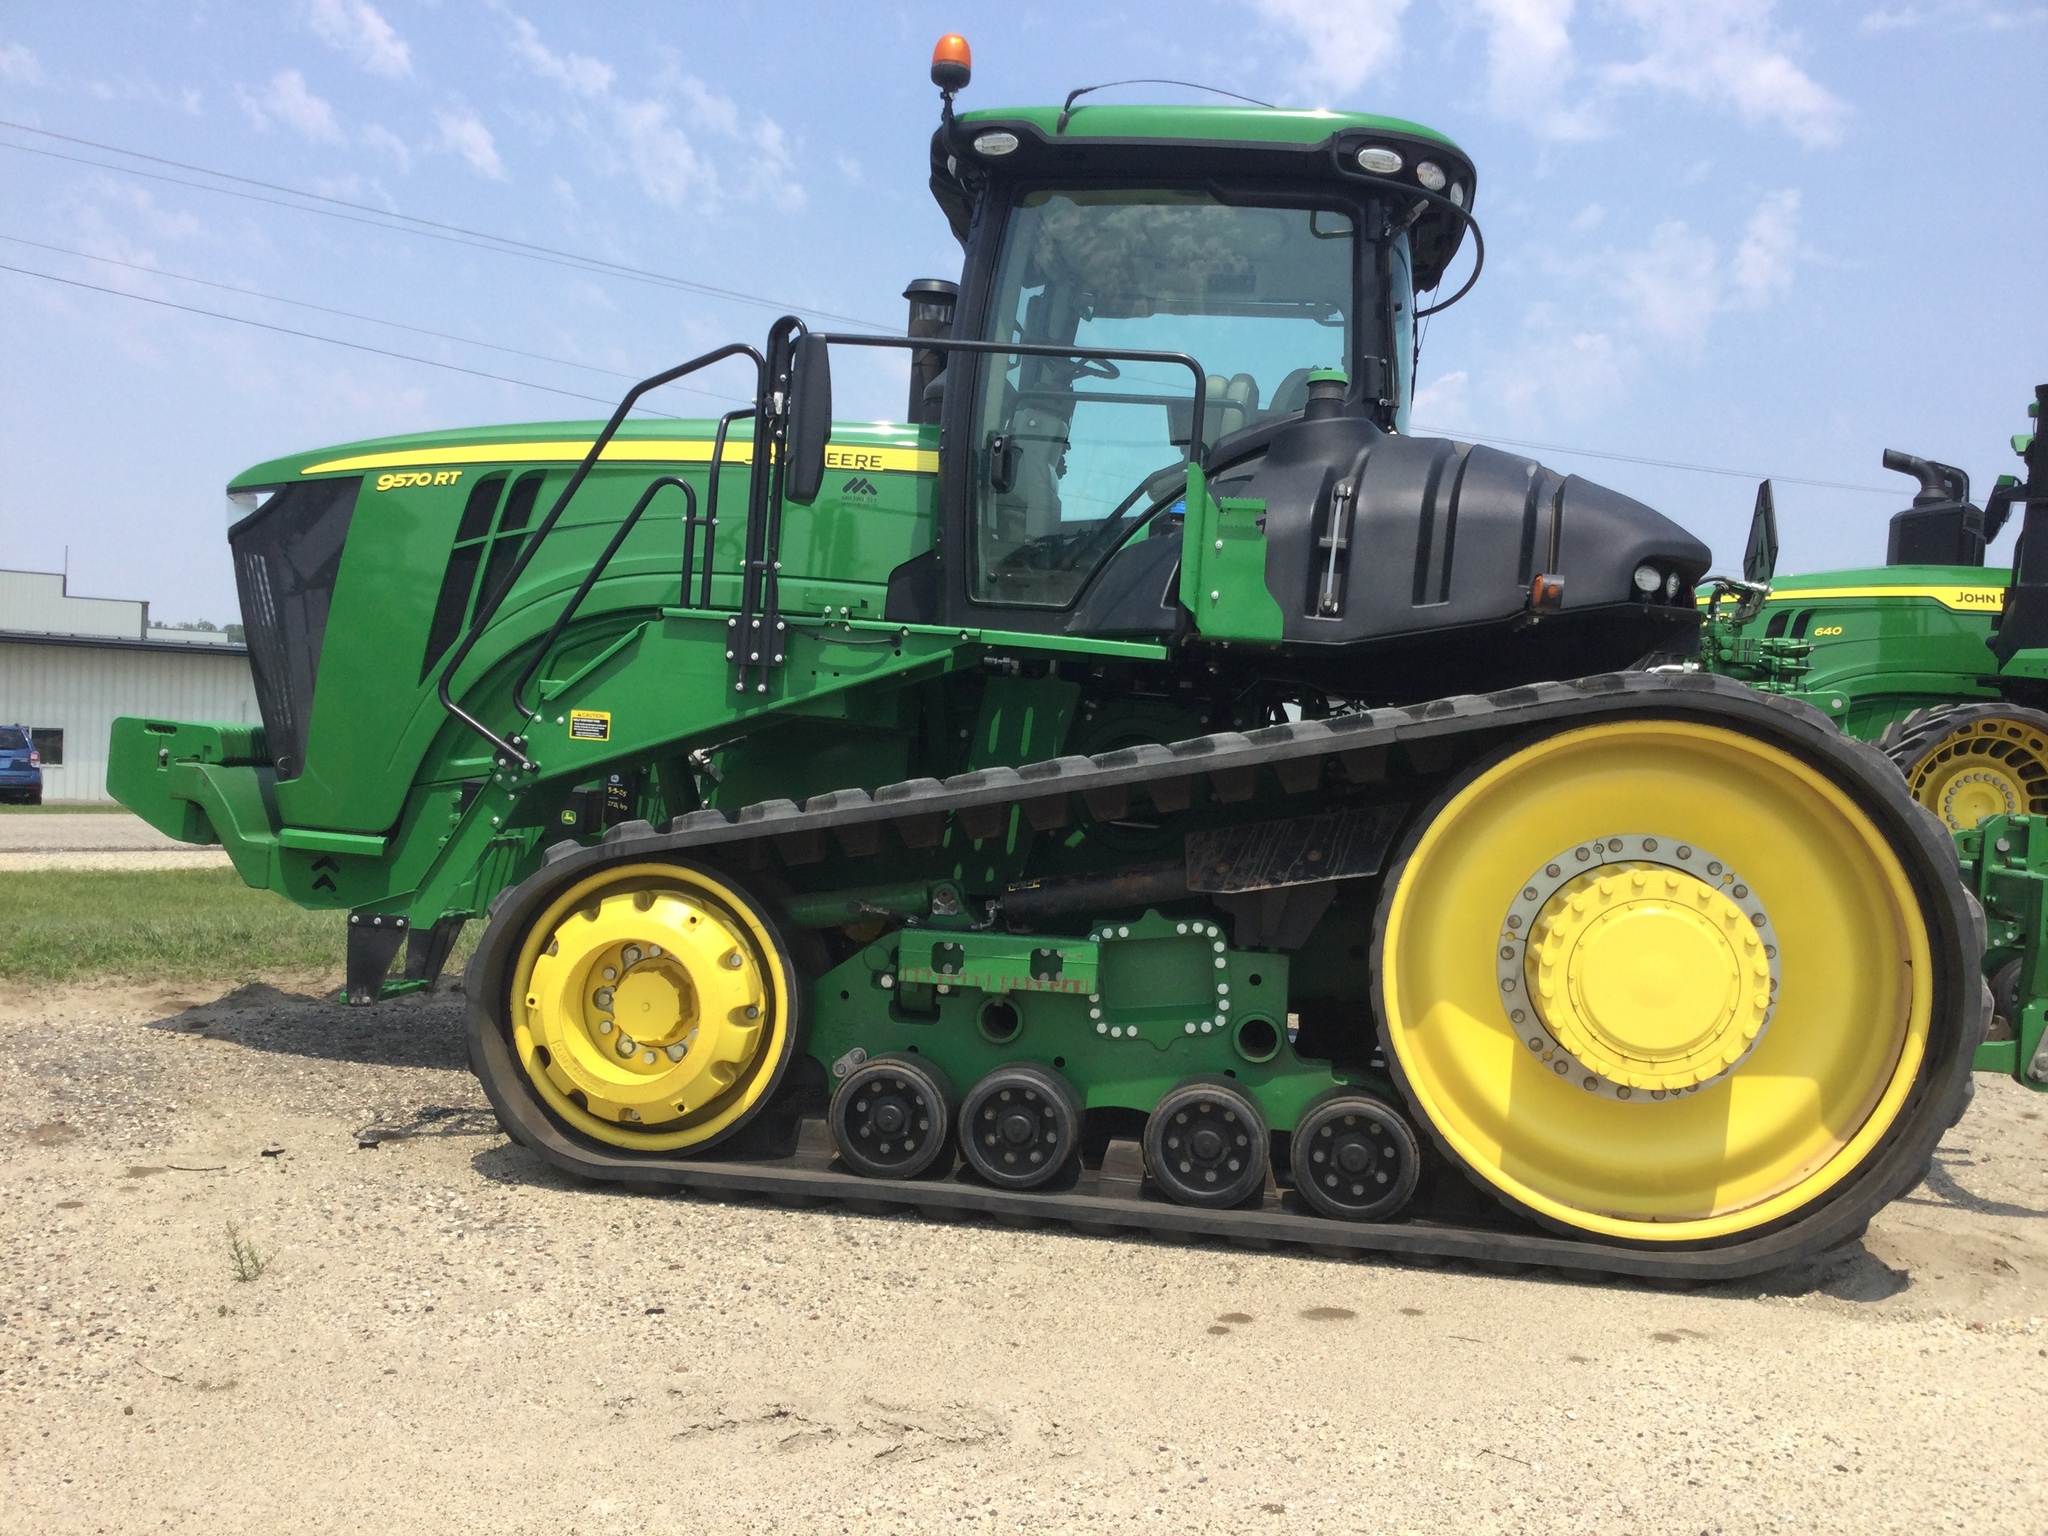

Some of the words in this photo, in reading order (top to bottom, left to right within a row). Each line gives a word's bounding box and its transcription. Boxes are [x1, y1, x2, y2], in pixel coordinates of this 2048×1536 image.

[826, 452, 882, 468] EERE
[376, 472, 432, 490] 9570
[433, 471, 463, 486] RT
[1955, 591, 1996, 604] JOHN
[1814, 626, 1842, 636] 640
